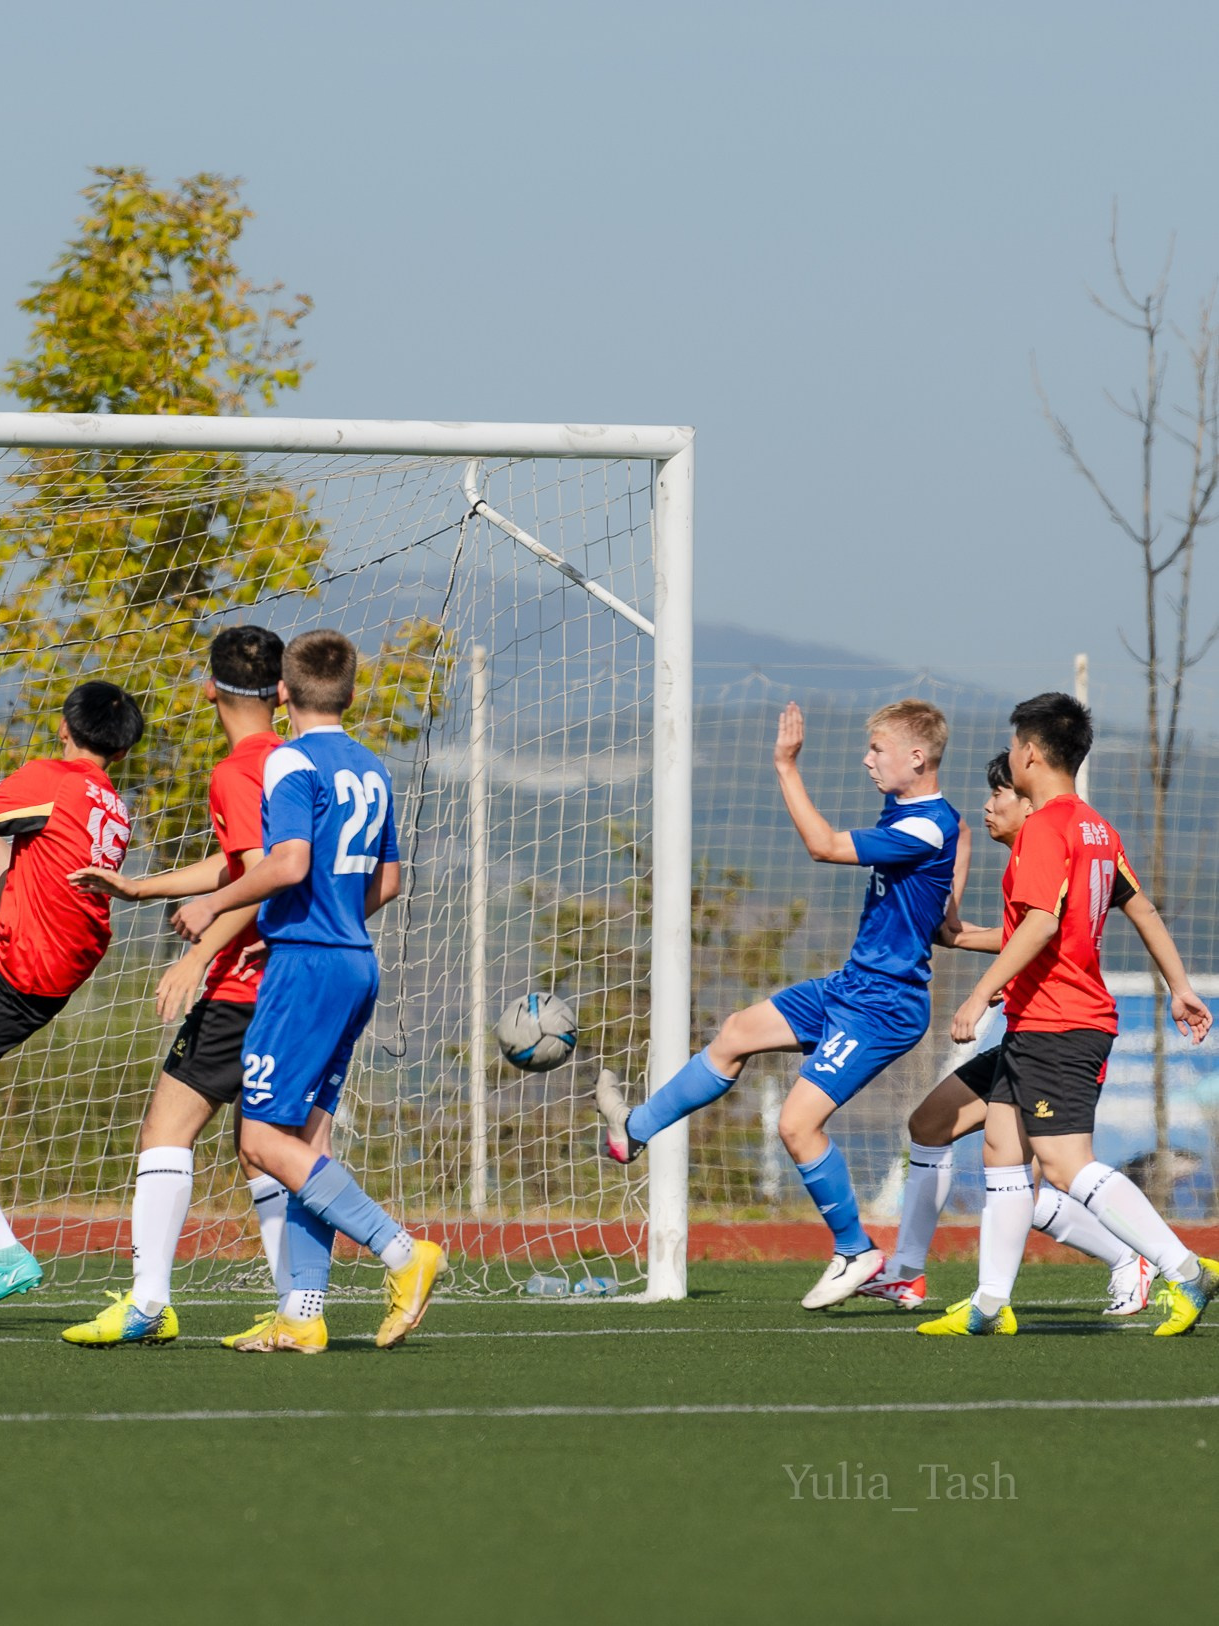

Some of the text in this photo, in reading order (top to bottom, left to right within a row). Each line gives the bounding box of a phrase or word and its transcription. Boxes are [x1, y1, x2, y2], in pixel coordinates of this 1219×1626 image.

[333, 768, 388, 875] 22
[822, 1031, 859, 1069] 41
[242, 1053, 275, 1091] 22
